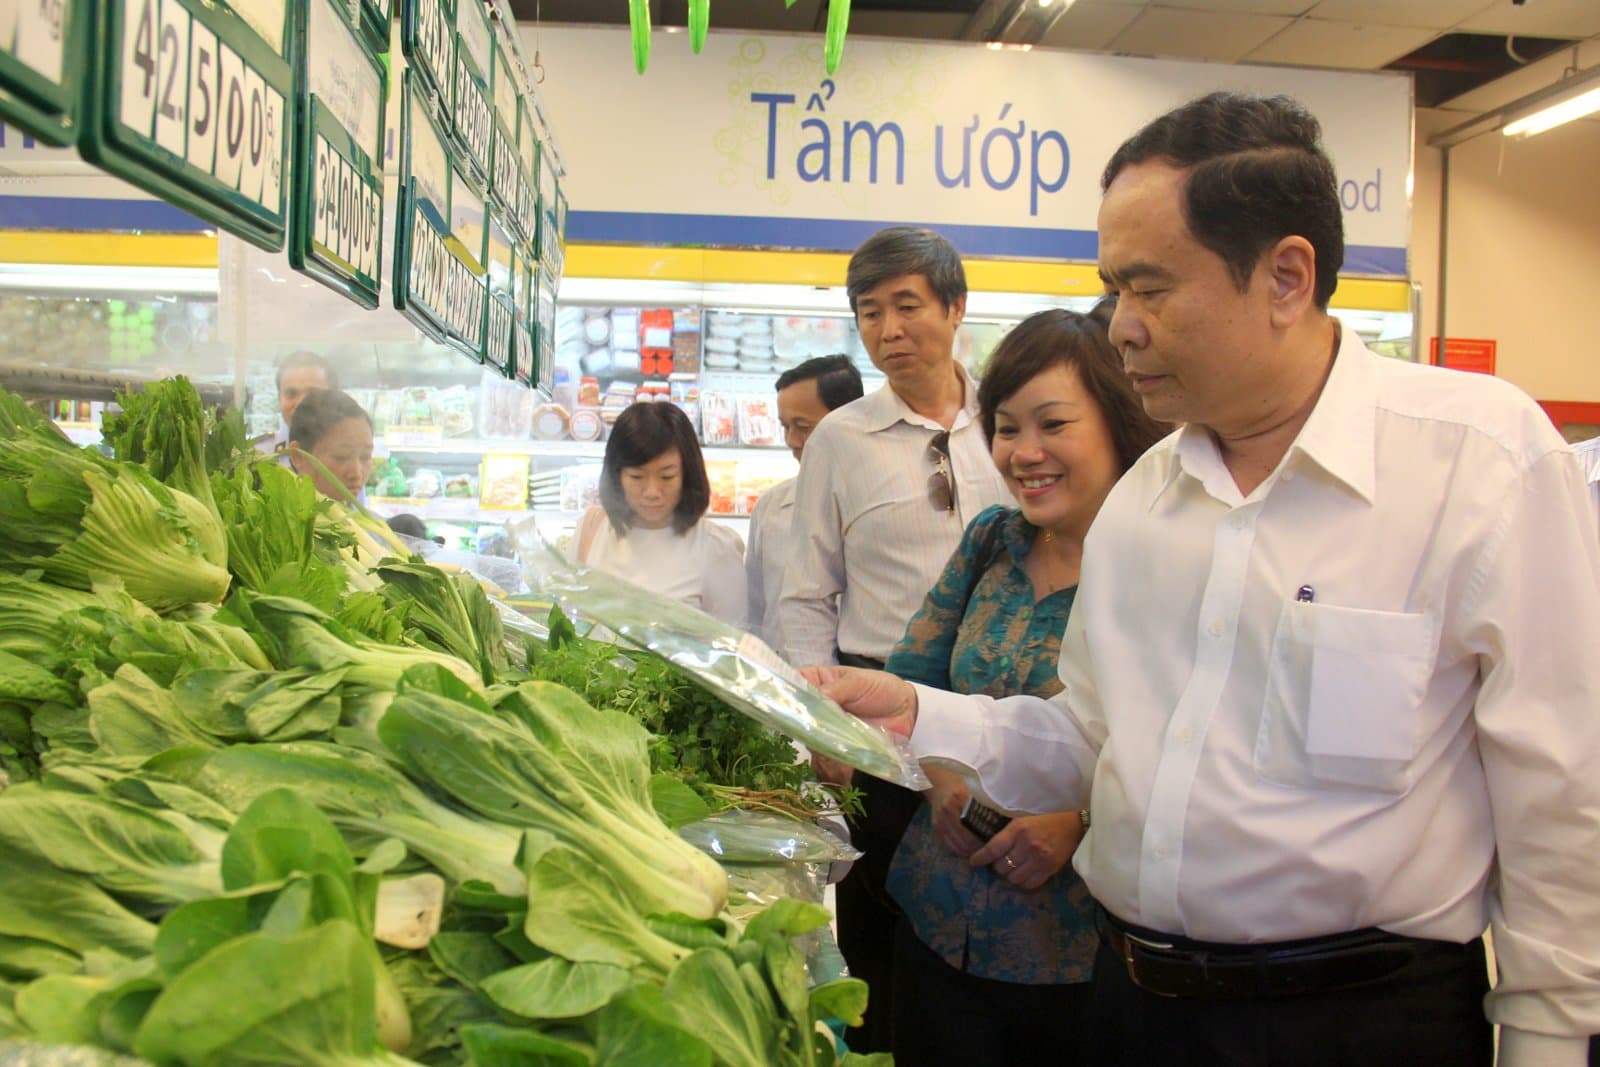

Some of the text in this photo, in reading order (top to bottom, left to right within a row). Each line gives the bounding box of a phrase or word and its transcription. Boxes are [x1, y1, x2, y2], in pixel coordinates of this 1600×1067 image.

[751, 79, 1071, 216] Tẩm ướp
[1340, 168, 1381, 213] od
